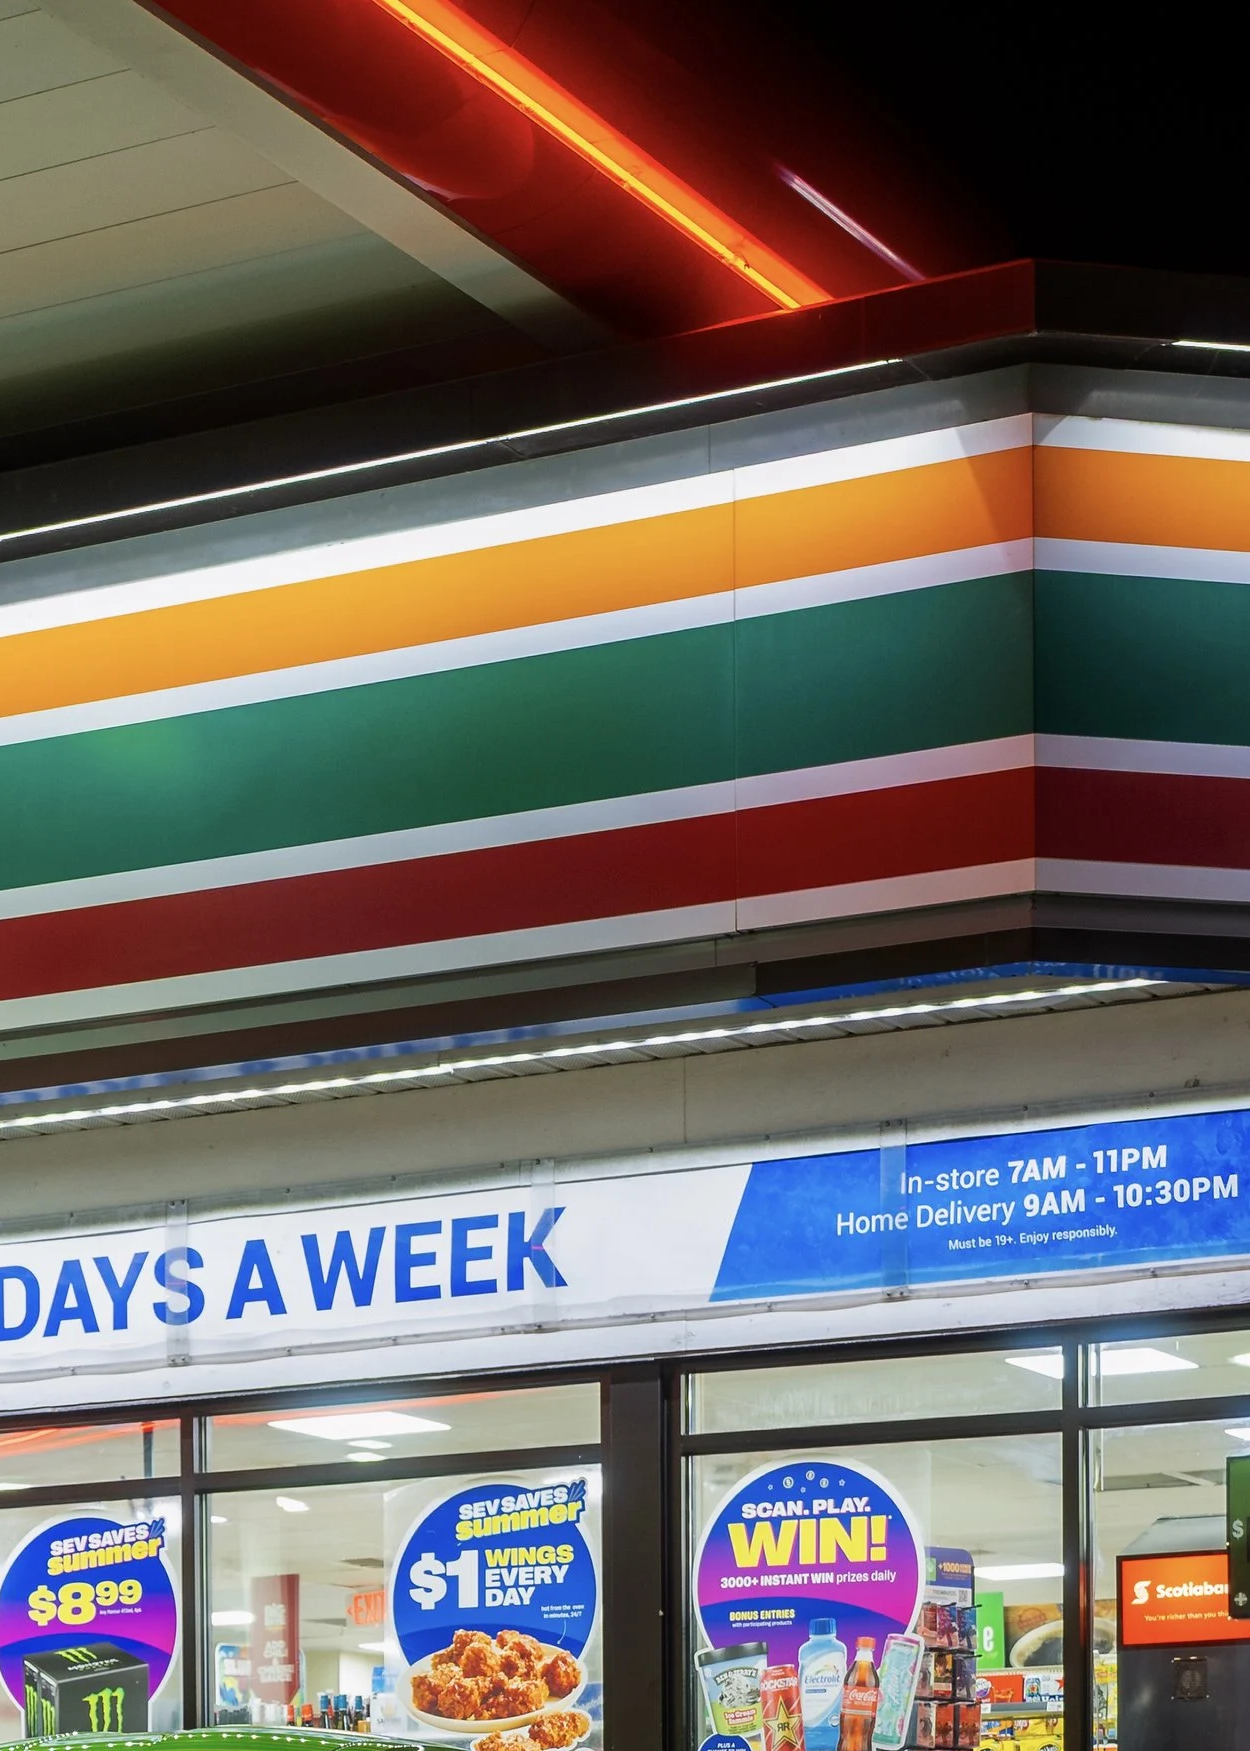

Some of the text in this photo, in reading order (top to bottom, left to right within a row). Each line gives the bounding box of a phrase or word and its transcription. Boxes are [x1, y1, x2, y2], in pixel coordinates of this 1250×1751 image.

[900, 1166, 1000, 1195] In-store
[1007, 1155, 1067, 1182] 7AM
[1092, 1144, 1168, 1175] 11PM
[836, 1208, 909, 1236] Home
[916, 1198, 1016, 1232] Delivery
[1023, 1190, 1086, 1218] 9AM
[1112, 1173, 1239, 1208] 10:30PM
[948, 1223, 1119, 1251] Must be 19+. Enjoy responsibly.
[225, 1238, 288, 1320] A
[300, 1205, 569, 1312] WEEK
[459, 1487, 569, 1520] SEV SAVES
[741, 1497, 871, 1519] SCAN. PLAY.
[456, 1500, 582, 1541] summer
[50, 1524, 150, 1556] SEV SAVES
[728, 1515, 887, 1568] WIN!
[47, 1537, 162, 1576] summer
[485, 1544, 575, 1567] WINGS
[409, 1549, 479, 1611] $1
[485, 1565, 569, 1588] EVERY
[720, 1569, 897, 1589] 3000+ INSTANT WIN prizes daily
[28, 1578, 143, 1627] $899
[485, 1586, 536, 1608] DAY
[729, 1608, 796, 1622] BONUS ENTRIES
[743, 1620, 771, 1629] participating
[772, 1619, 793, 1627] products
[1144, 1612, 1216, 1623] You're richer than you
[804, 1674, 841, 1685] Electrolit
